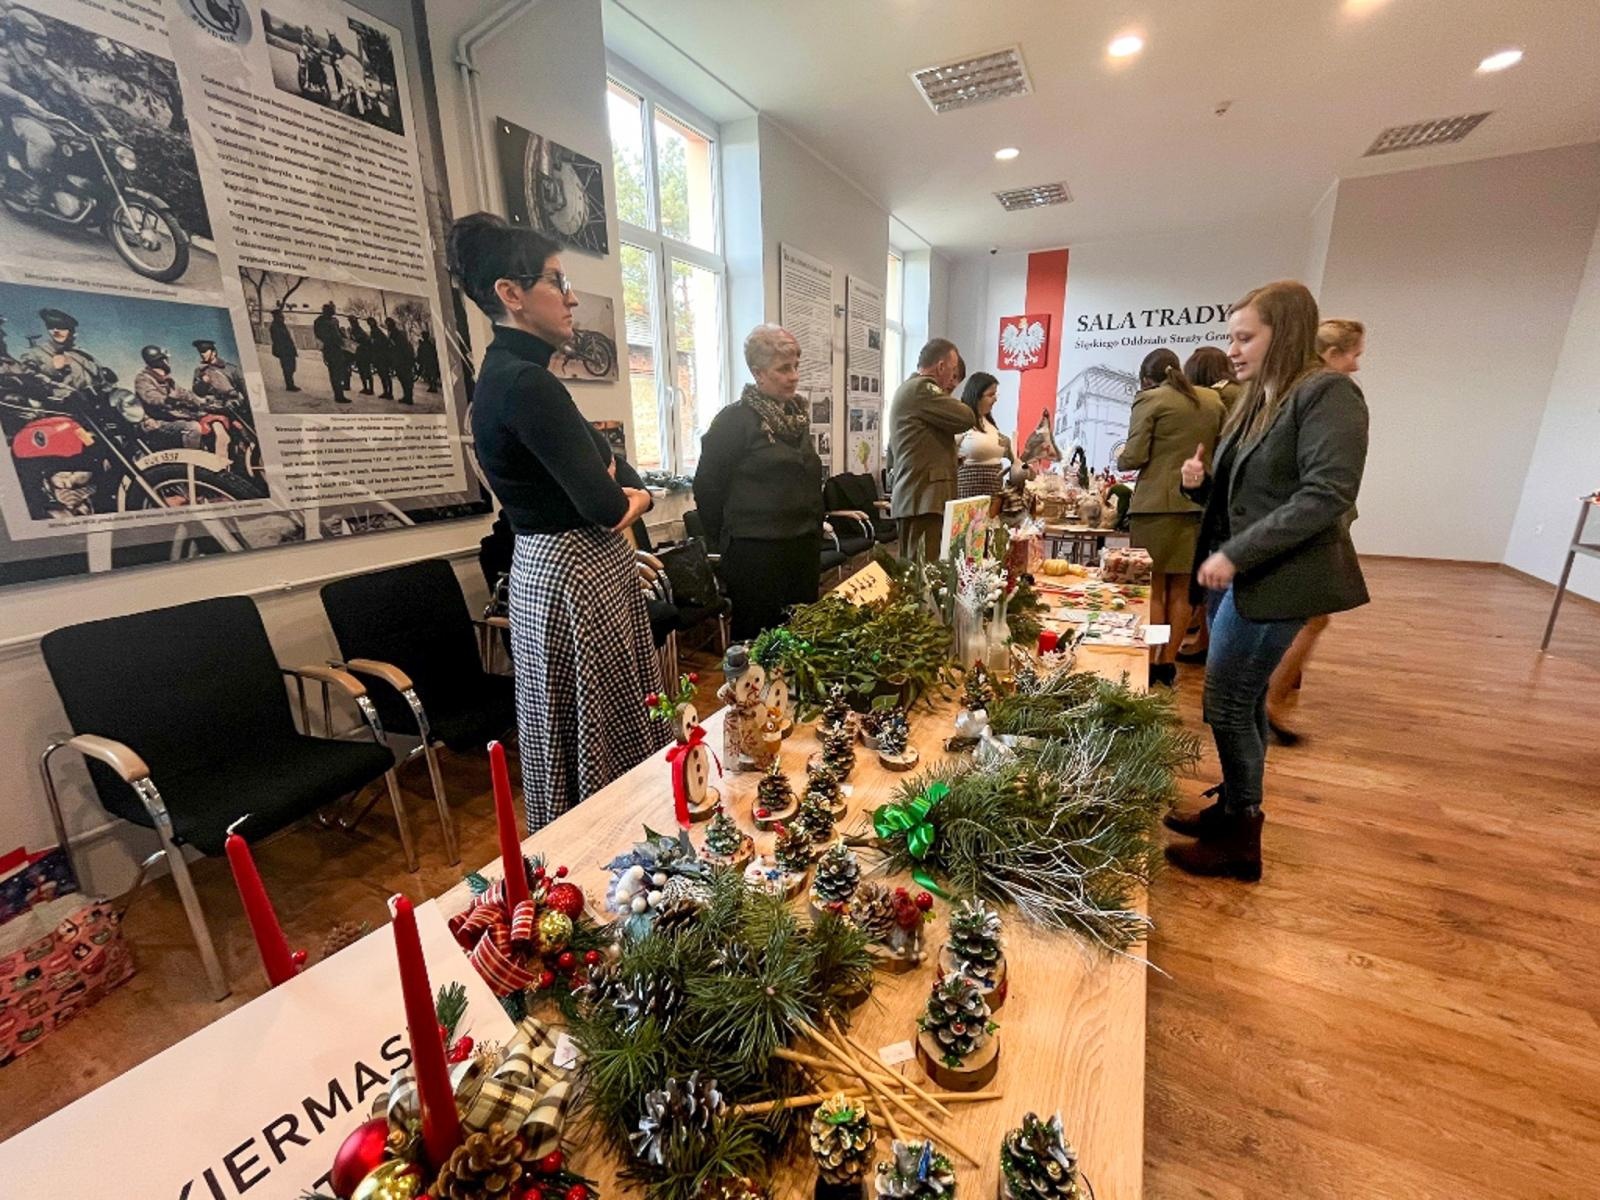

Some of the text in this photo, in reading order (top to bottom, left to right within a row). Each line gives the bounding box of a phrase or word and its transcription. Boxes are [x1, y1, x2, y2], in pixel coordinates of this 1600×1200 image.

[1077, 304, 1232, 332] SALA TRADY
[1205, 331, 1233, 341] Gran
[179, 1026, 413, 1200] IERMAS
